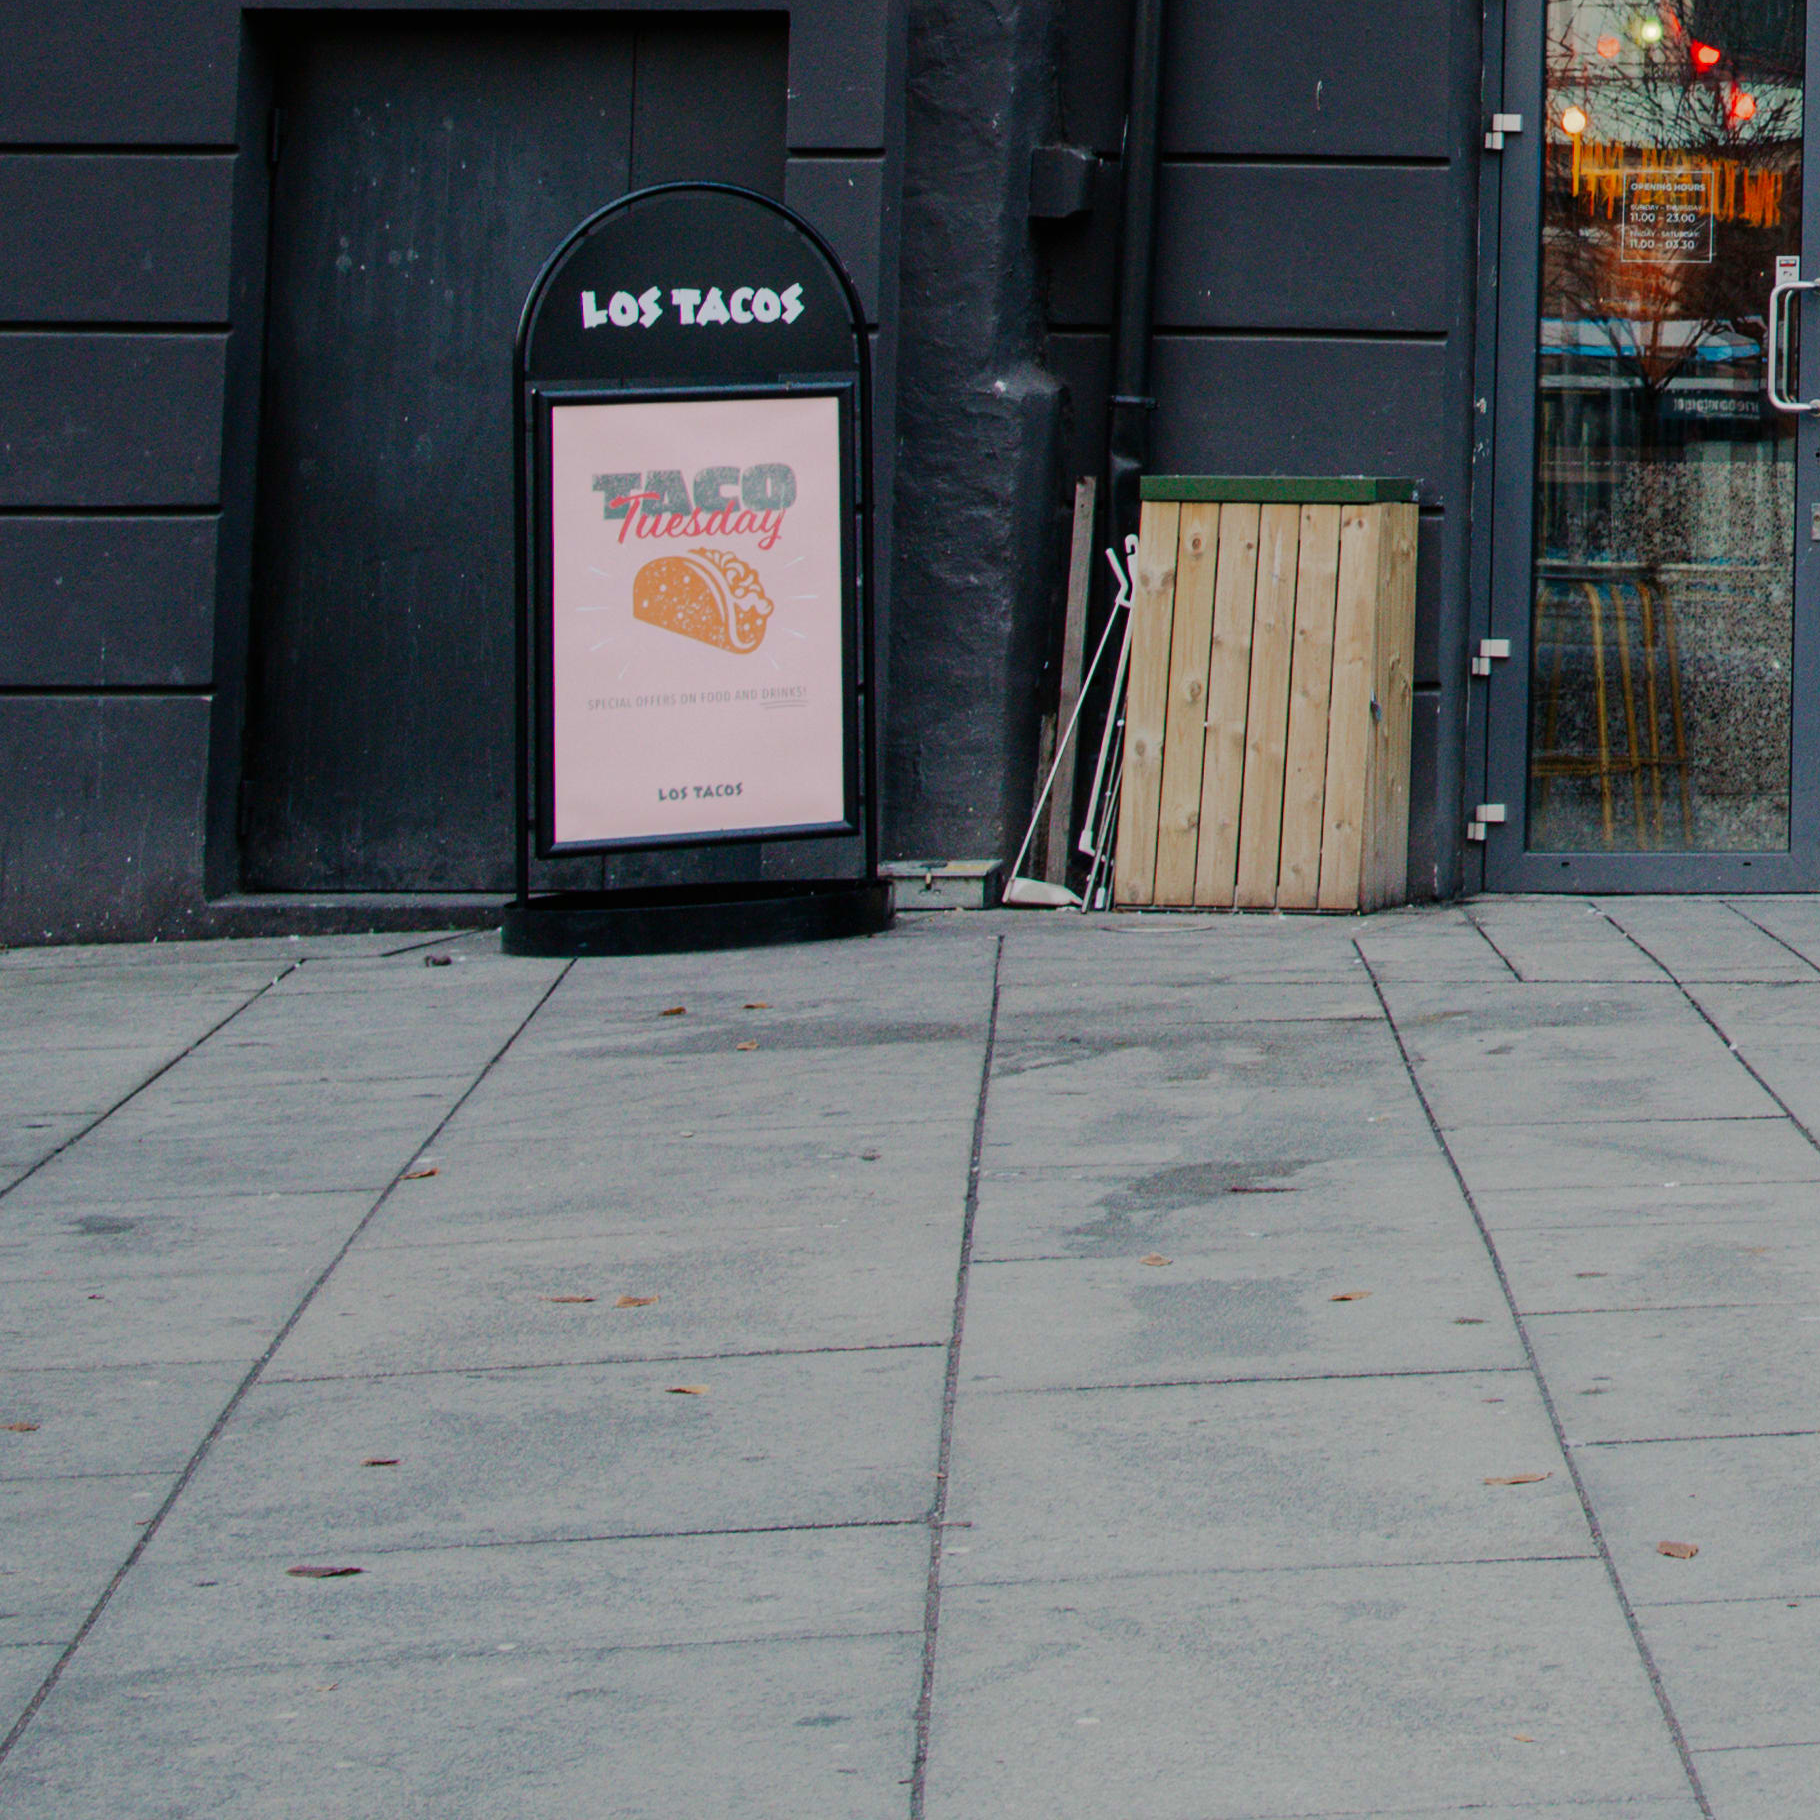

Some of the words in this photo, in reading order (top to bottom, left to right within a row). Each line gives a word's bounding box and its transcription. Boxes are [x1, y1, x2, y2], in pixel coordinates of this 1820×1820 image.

[1630, 183, 1673, 192] OPENING
[1674, 183, 1706, 192] HOURS
[1630, 212, 1656, 223] 11.00
[1666, 212, 1696, 224] 23.00
[581, 285, 663, 329] LOS
[671, 282, 805, 327] TACOS
[592, 463, 798, 520] TACO
[609, 492, 786, 550] Tuesday
[587, 697, 633, 712] SPECIAL
[636, 694, 677, 708] OFFERS
[680, 692, 698, 706] ON
[700, 689, 732, 704] FOOD
[734, 687, 759, 702] AND
[761, 685, 808, 700] DRINKS!
[658, 785, 688, 802] LOS
[693, 782, 744, 800] TACOS
